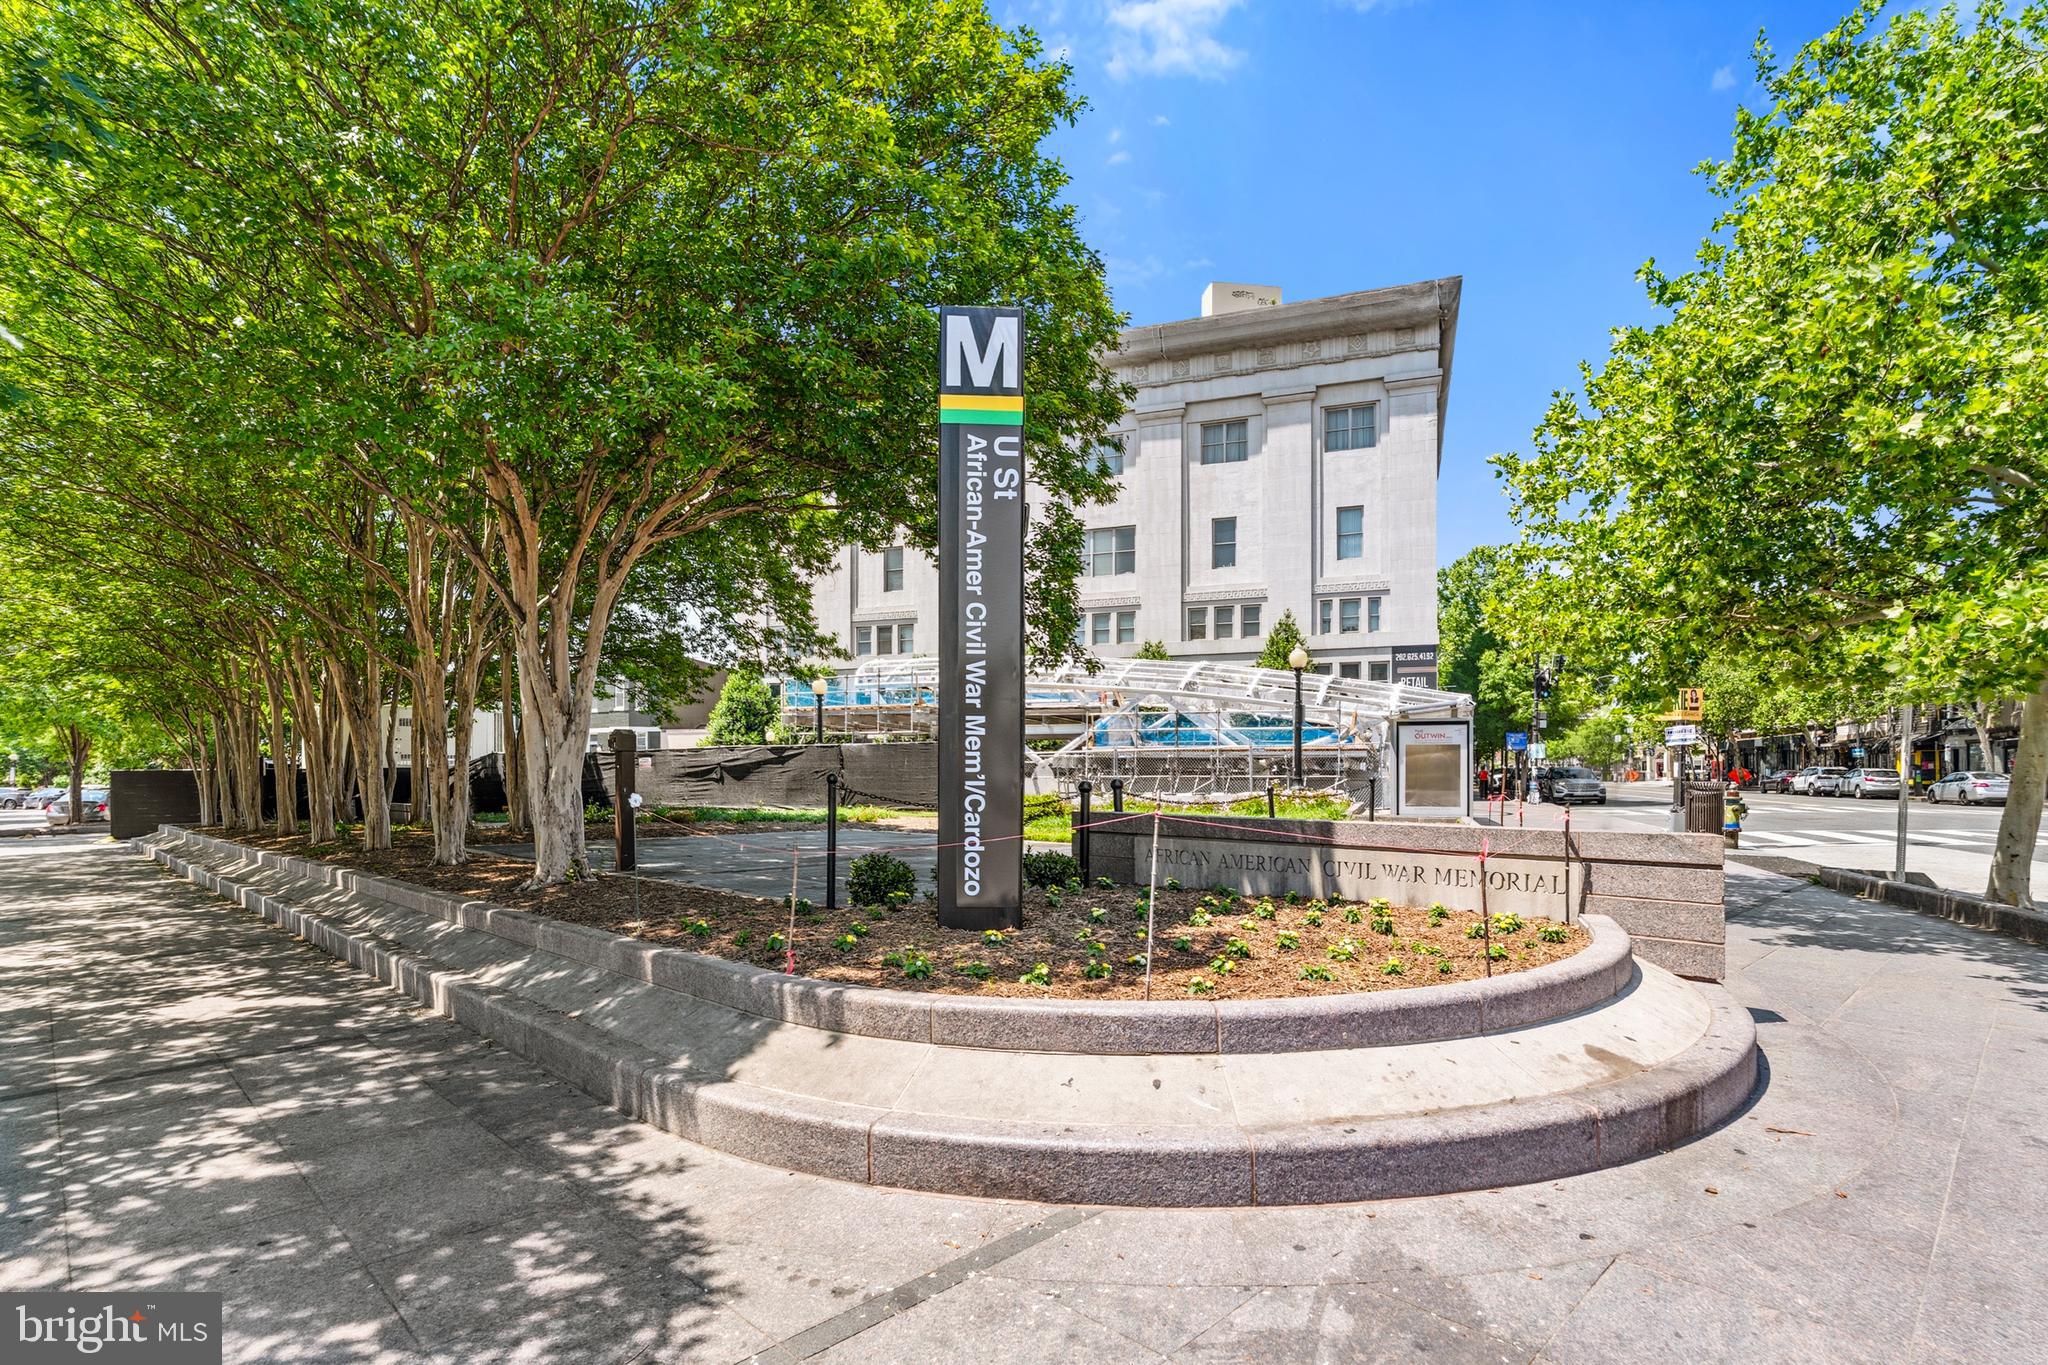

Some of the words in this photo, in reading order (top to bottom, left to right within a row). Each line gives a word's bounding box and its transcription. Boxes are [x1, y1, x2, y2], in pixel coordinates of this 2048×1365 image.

[946, 315, 1018, 388] M
[993, 436, 1019, 457] U
[993, 467, 1019, 500] St
[966, 433, 988, 596] African-Amer
[965, 602, 987, 655] Civil
[965, 660, 987, 709] War
[1400, 676, 1429, 688] RETAIL
[1414, 732, 1446, 740] OUTWIN
[963, 715, 986, 897] Mem'l/Cardozo
[1144, 848, 1211, 867] AFRICAN
[1219, 854, 1312, 874] AMERICAN
[1323, 859, 1377, 881] CIVIL
[1382, 863, 1427, 885] WAR
[1434, 867, 1567, 895] MEMORIAL
